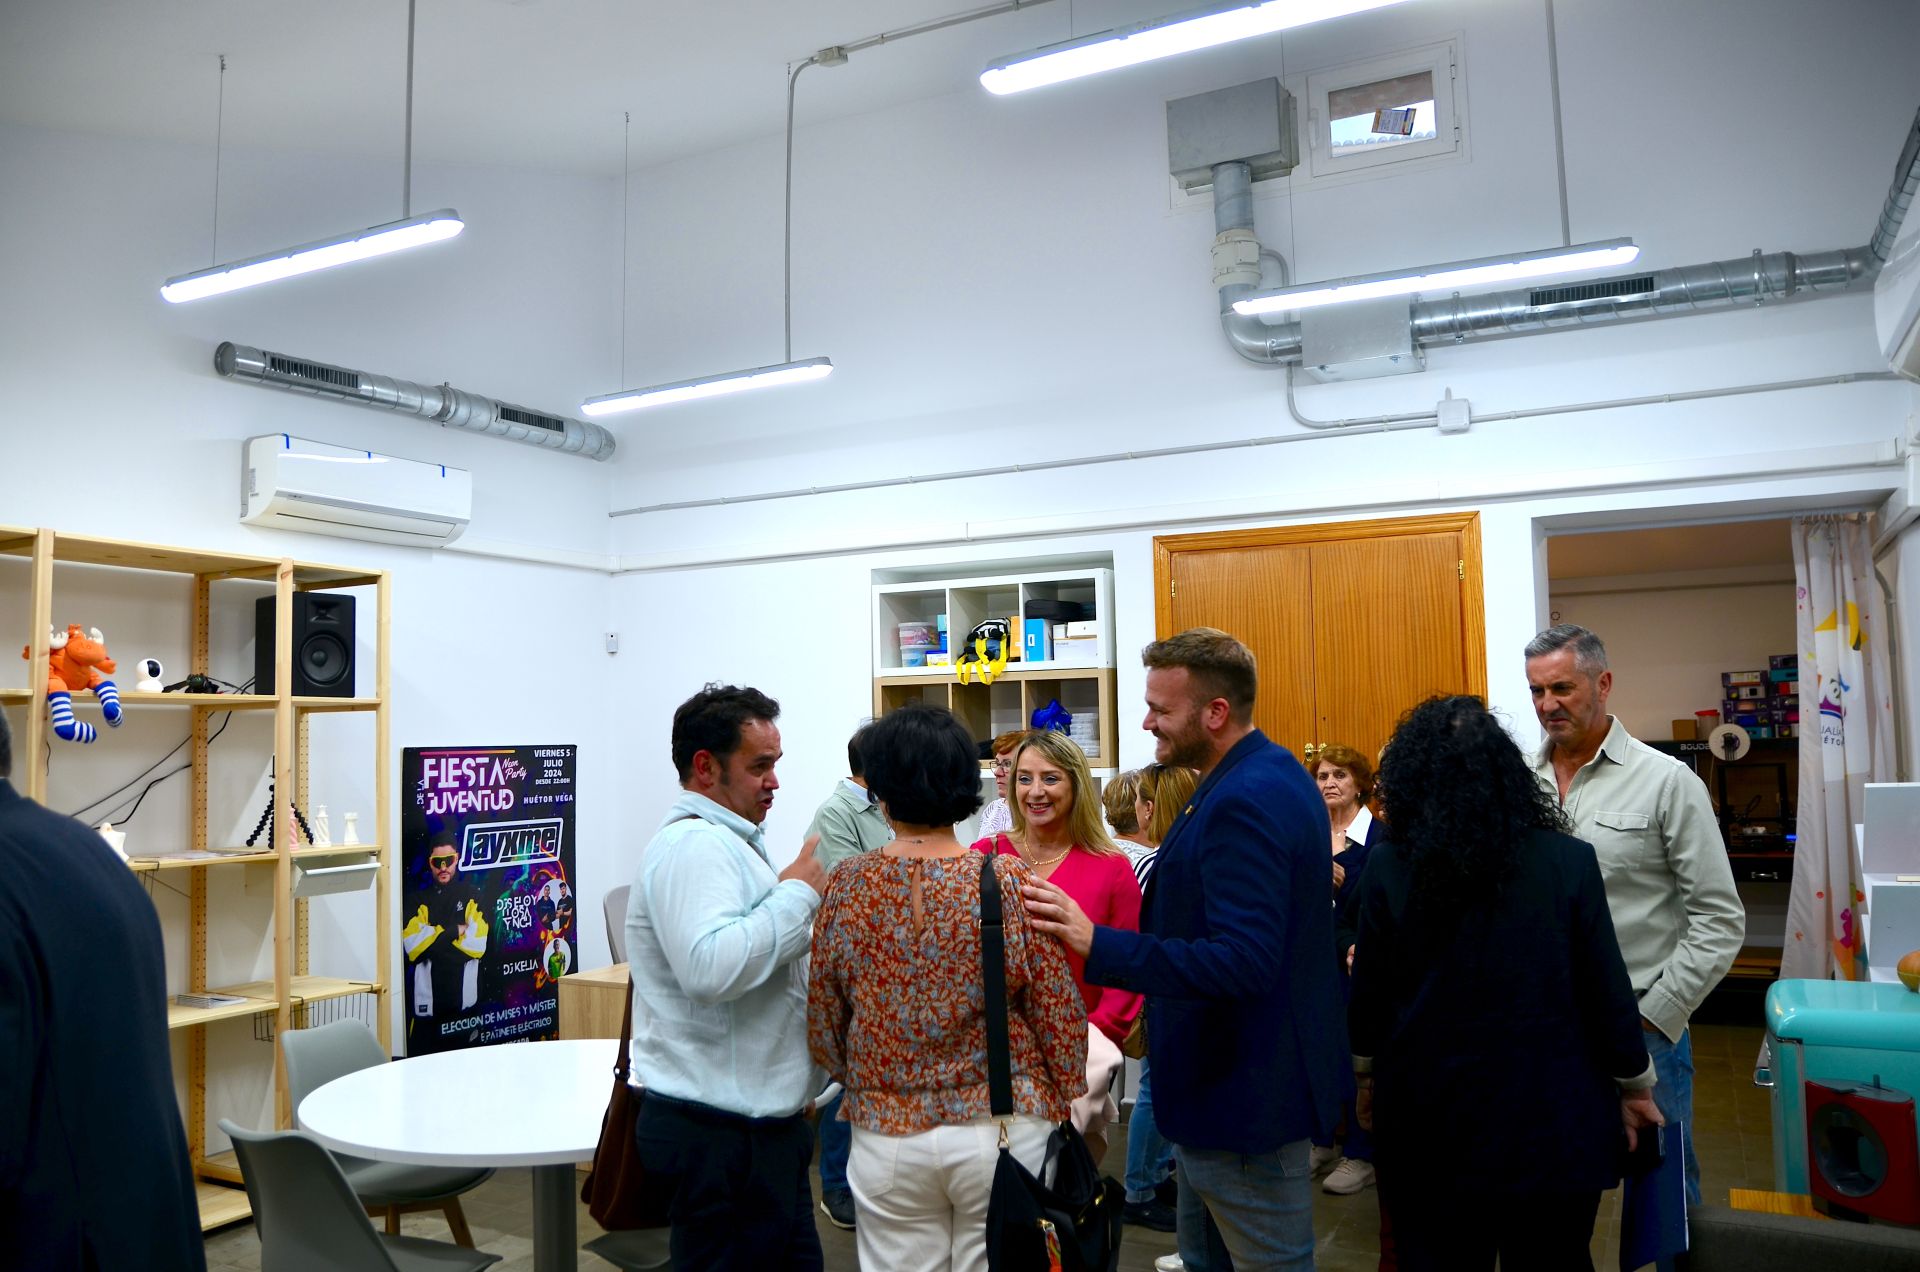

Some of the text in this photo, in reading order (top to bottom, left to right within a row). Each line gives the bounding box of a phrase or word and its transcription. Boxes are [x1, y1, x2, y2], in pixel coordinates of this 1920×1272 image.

[534, 749, 571, 757] VIERNES 5
[543, 759, 563, 767] JULIO
[424, 757, 506, 789] FIESTA
[505, 766, 527, 780] Party
[543, 769, 562, 777] 2024
[426, 789, 514, 814] JUVENTUD
[523, 794, 573, 804] HUÉTOR VEGA
[485, 1012, 495, 1025] DE
[522, 1005, 528, 1015] Y
